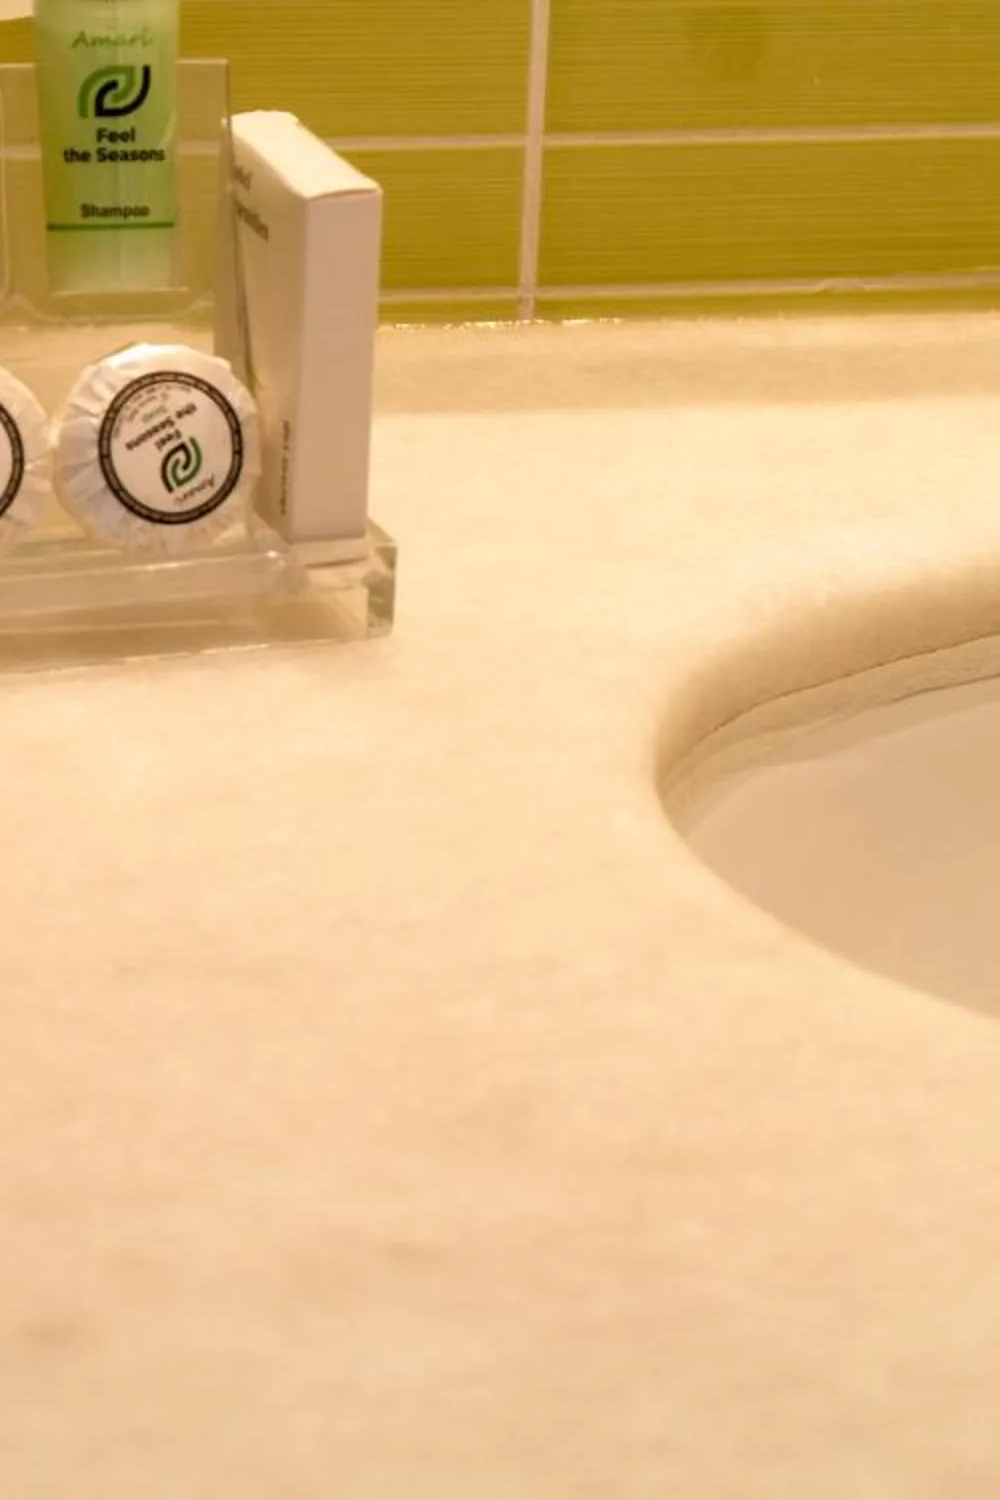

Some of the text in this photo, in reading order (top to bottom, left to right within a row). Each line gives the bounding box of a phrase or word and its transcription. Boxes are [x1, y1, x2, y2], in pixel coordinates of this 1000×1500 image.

[95, 127, 136, 144] Feel
[63, 146, 165, 164] the Seasons
[79, 203, 150, 220] Shampoo
